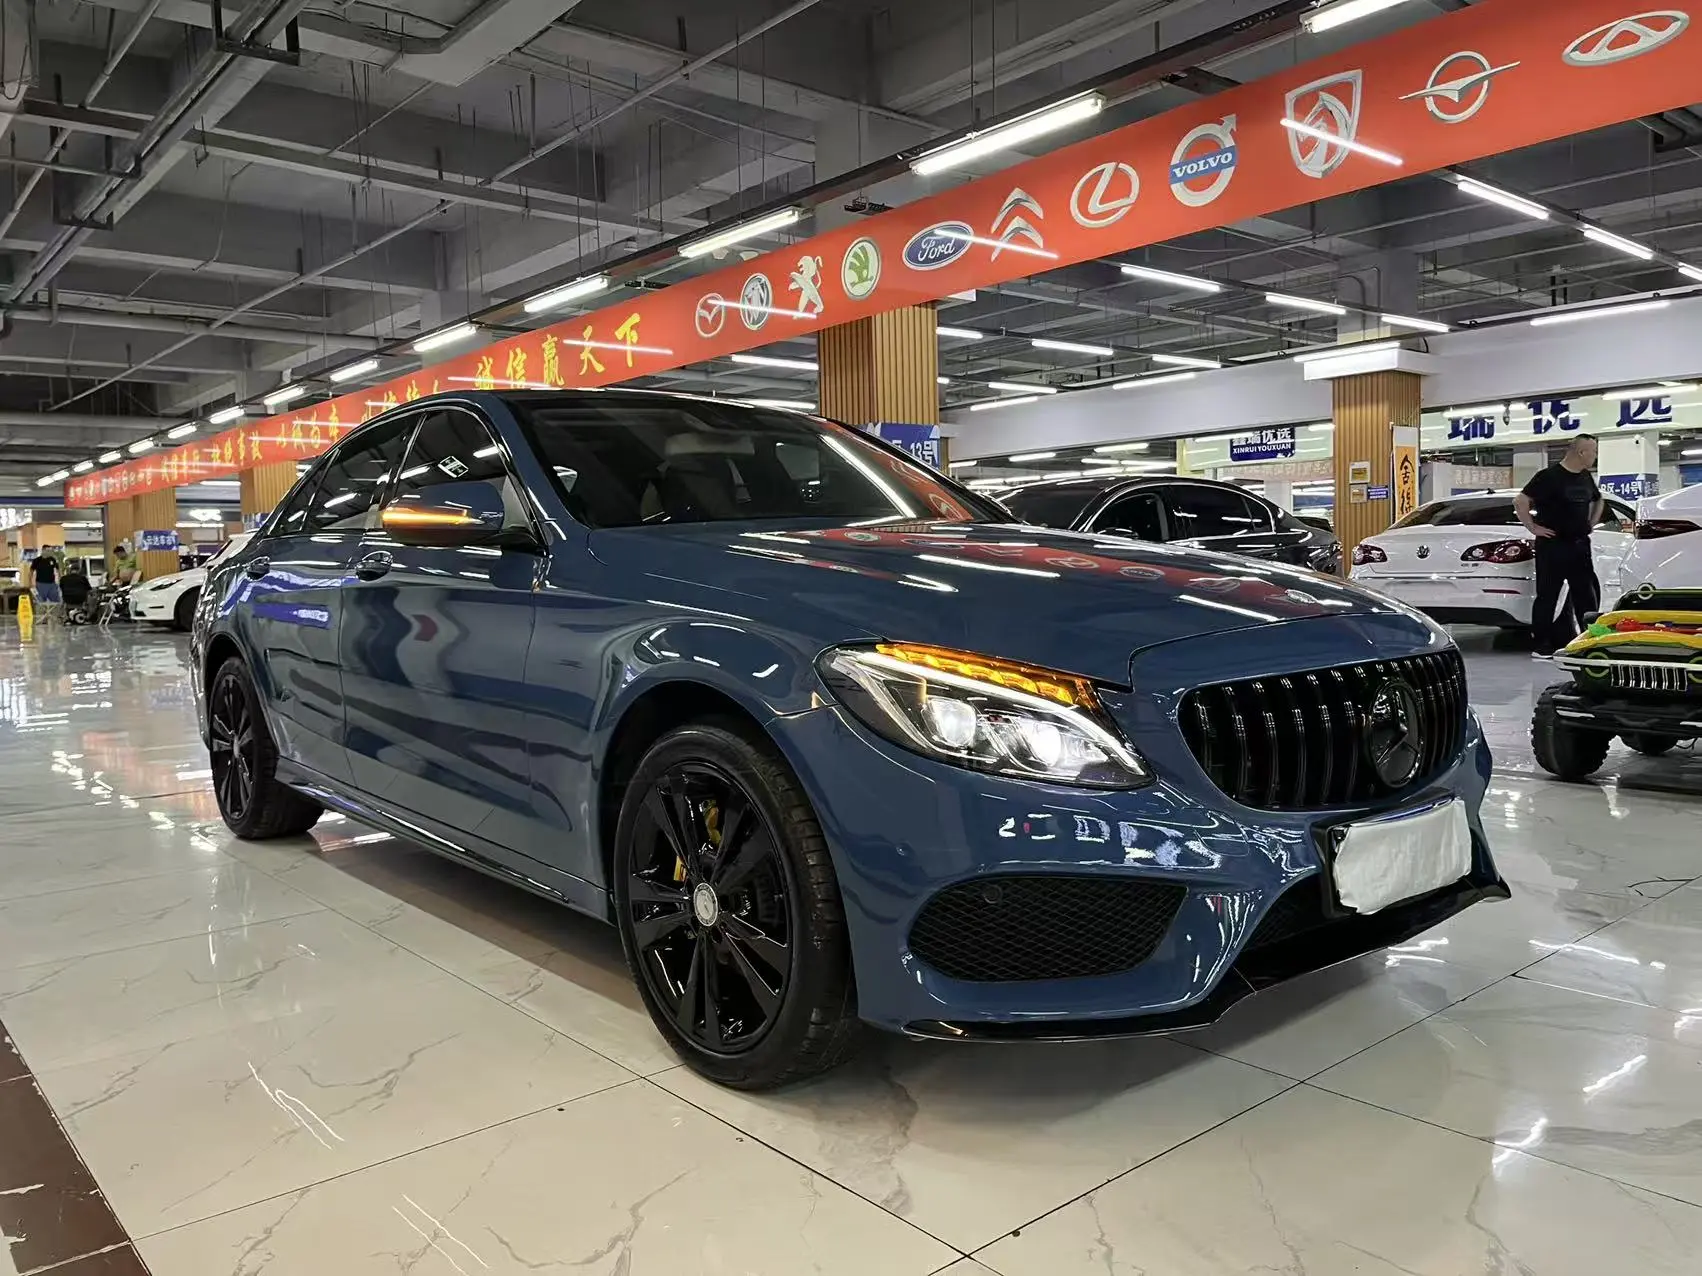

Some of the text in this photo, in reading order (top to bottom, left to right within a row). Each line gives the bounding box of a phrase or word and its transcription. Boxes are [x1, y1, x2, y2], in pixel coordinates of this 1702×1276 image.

[1173, 152, 1233, 178] VOLVO
[918, 236, 956, 262] Ford
[474, 313, 641, 390] 诚信赢天下
[1232, 442, 1292, 454] XINRUI YOUXUAN
[1400, 454, 1415, 514] 舍得
